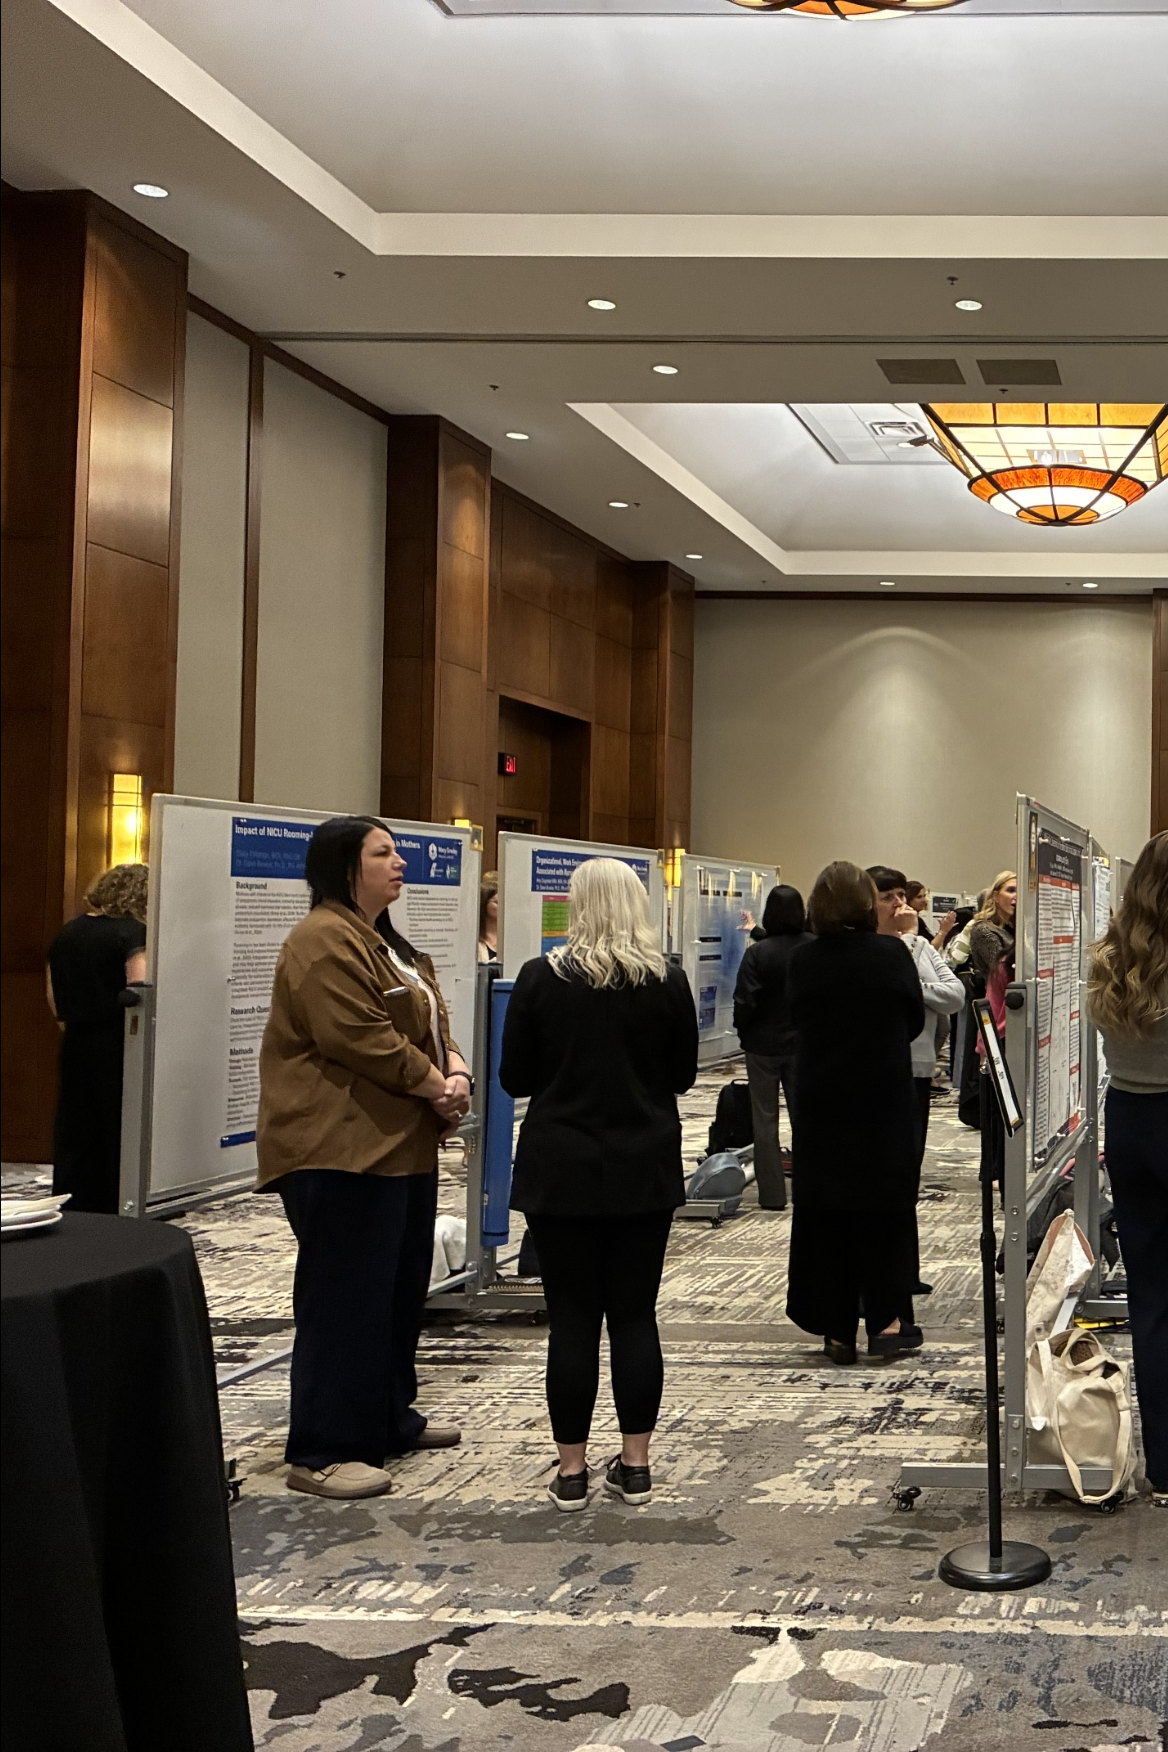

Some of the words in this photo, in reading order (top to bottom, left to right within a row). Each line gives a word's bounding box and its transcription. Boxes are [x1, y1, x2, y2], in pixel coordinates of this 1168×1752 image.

[235, 824, 258, 836] Impact
[258, 826, 266, 836] of
[267, 827, 282, 837] NICU
[283, 828, 313, 842] Rooming-I
[401, 839, 421, 849] Mothers
[536, 867, 555, 875] Associated
[236, 881, 268, 891] Background
[230, 1007, 255, 1015] Research
